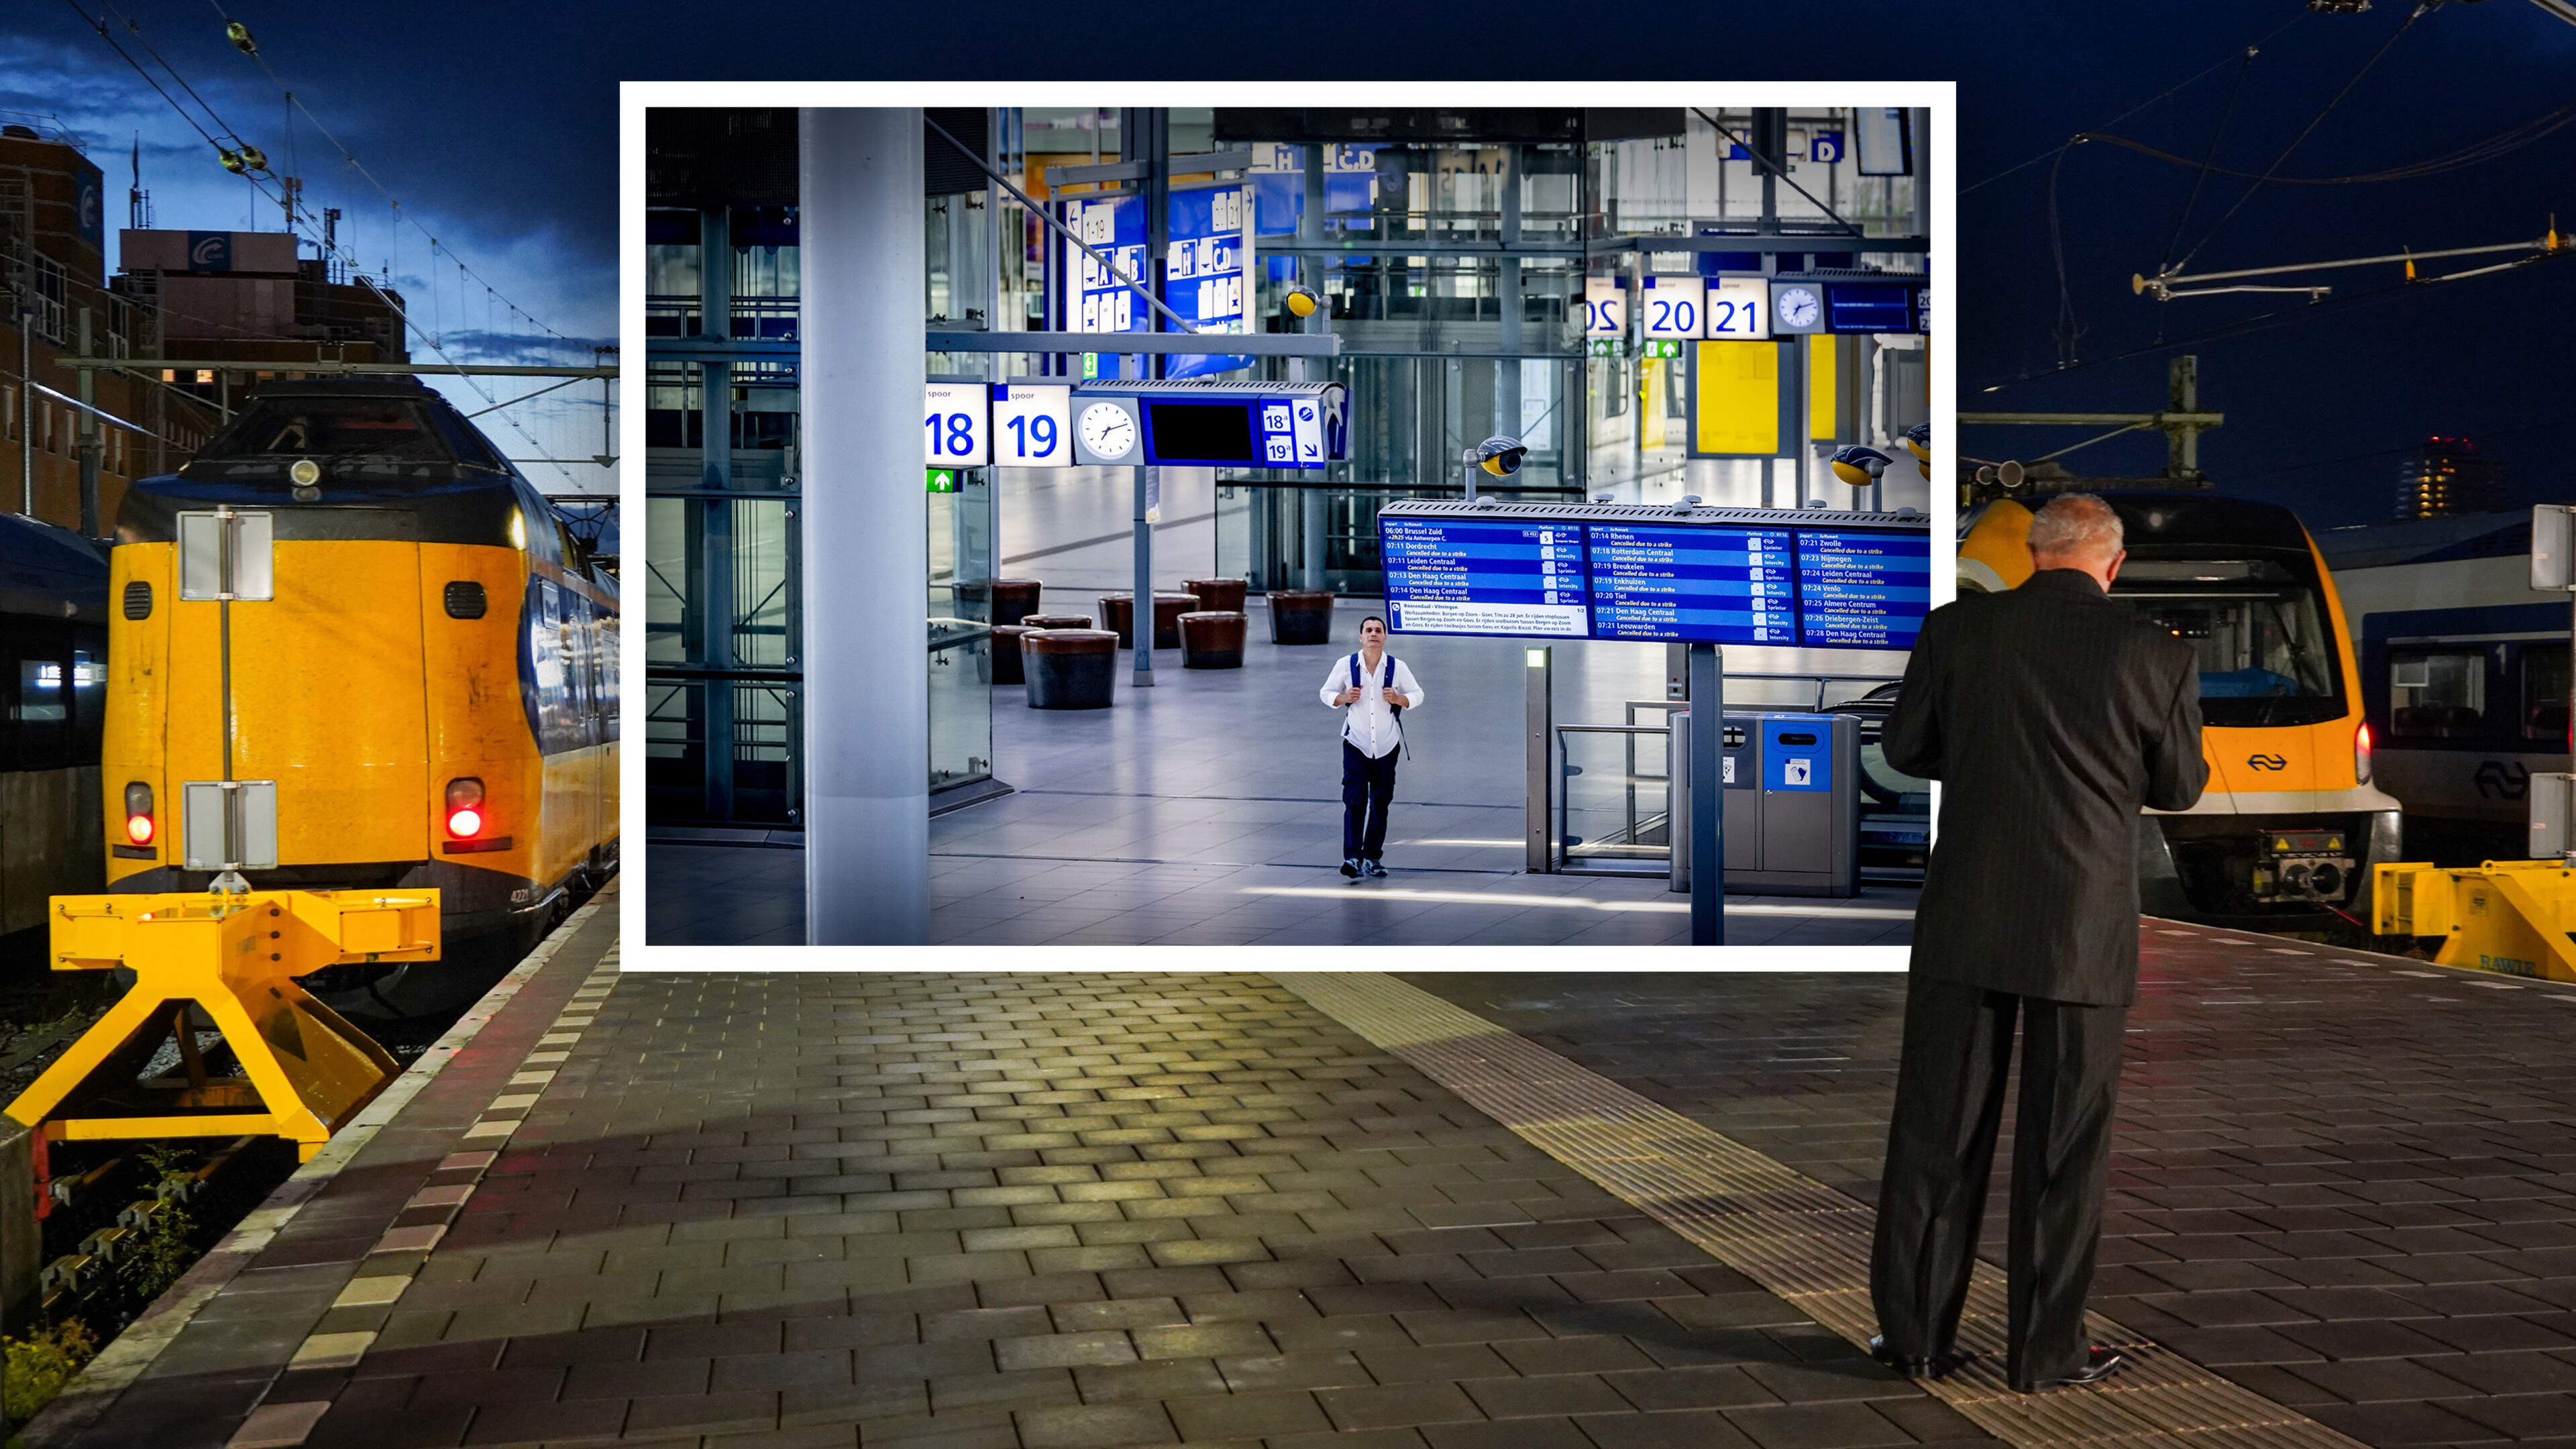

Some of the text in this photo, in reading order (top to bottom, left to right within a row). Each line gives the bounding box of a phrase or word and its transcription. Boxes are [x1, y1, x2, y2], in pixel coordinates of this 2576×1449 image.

[1277, 152, 1293, 170] H
[1818, 142, 1835, 162] D
[1130, 259, 1139, 281] B
[1183, 252, 1191, 275] H
[1099, 264, 1109, 285] A
[1652, 301, 1695, 332] 20
[1716, 301, 1755, 333] 21
[1922, 319, 1931, 329] 2
[925, 413, 974, 456] 18
[1007, 415, 1057, 458] 19
[1821, 555, 1851, 563] Nijmegen
[1825, 614, 1878, 624] Driebergen-Zeist
[1840, 631, 1857, 639] Haag
[2496, 643, 2506, 675] 1
